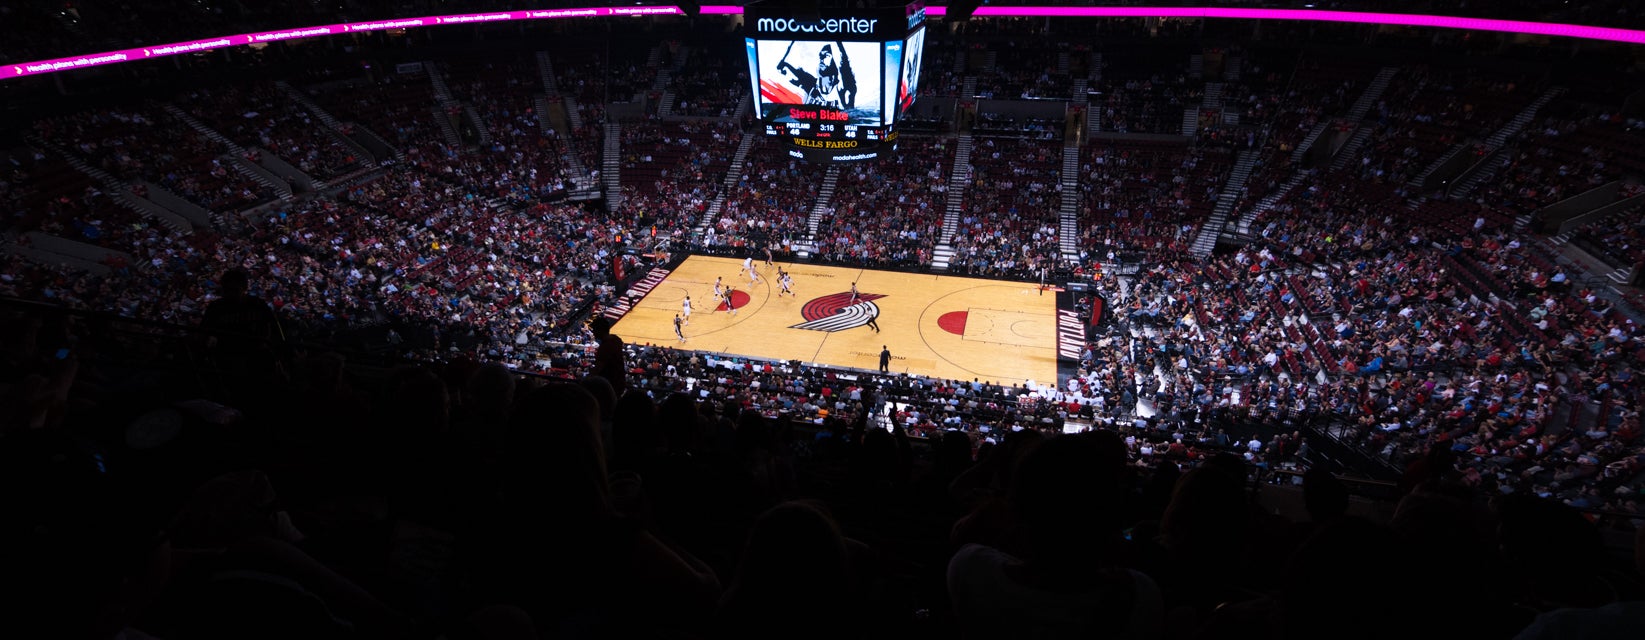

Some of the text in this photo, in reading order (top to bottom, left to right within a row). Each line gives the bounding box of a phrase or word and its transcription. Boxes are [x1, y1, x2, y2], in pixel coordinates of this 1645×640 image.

[152, 46, 173, 54] Health
[201, 39, 230, 49] personality
[26, 63, 53, 72] Health
[53, 62, 74, 70] plans
[89, 54, 127, 64] personality
[790, 108, 848, 120] Steve Blake
[794, 138, 858, 149] WELLS FARGO
[832, 152, 878, 160] modahealth.com
[1058, 309, 1085, 360] PORTLAND
